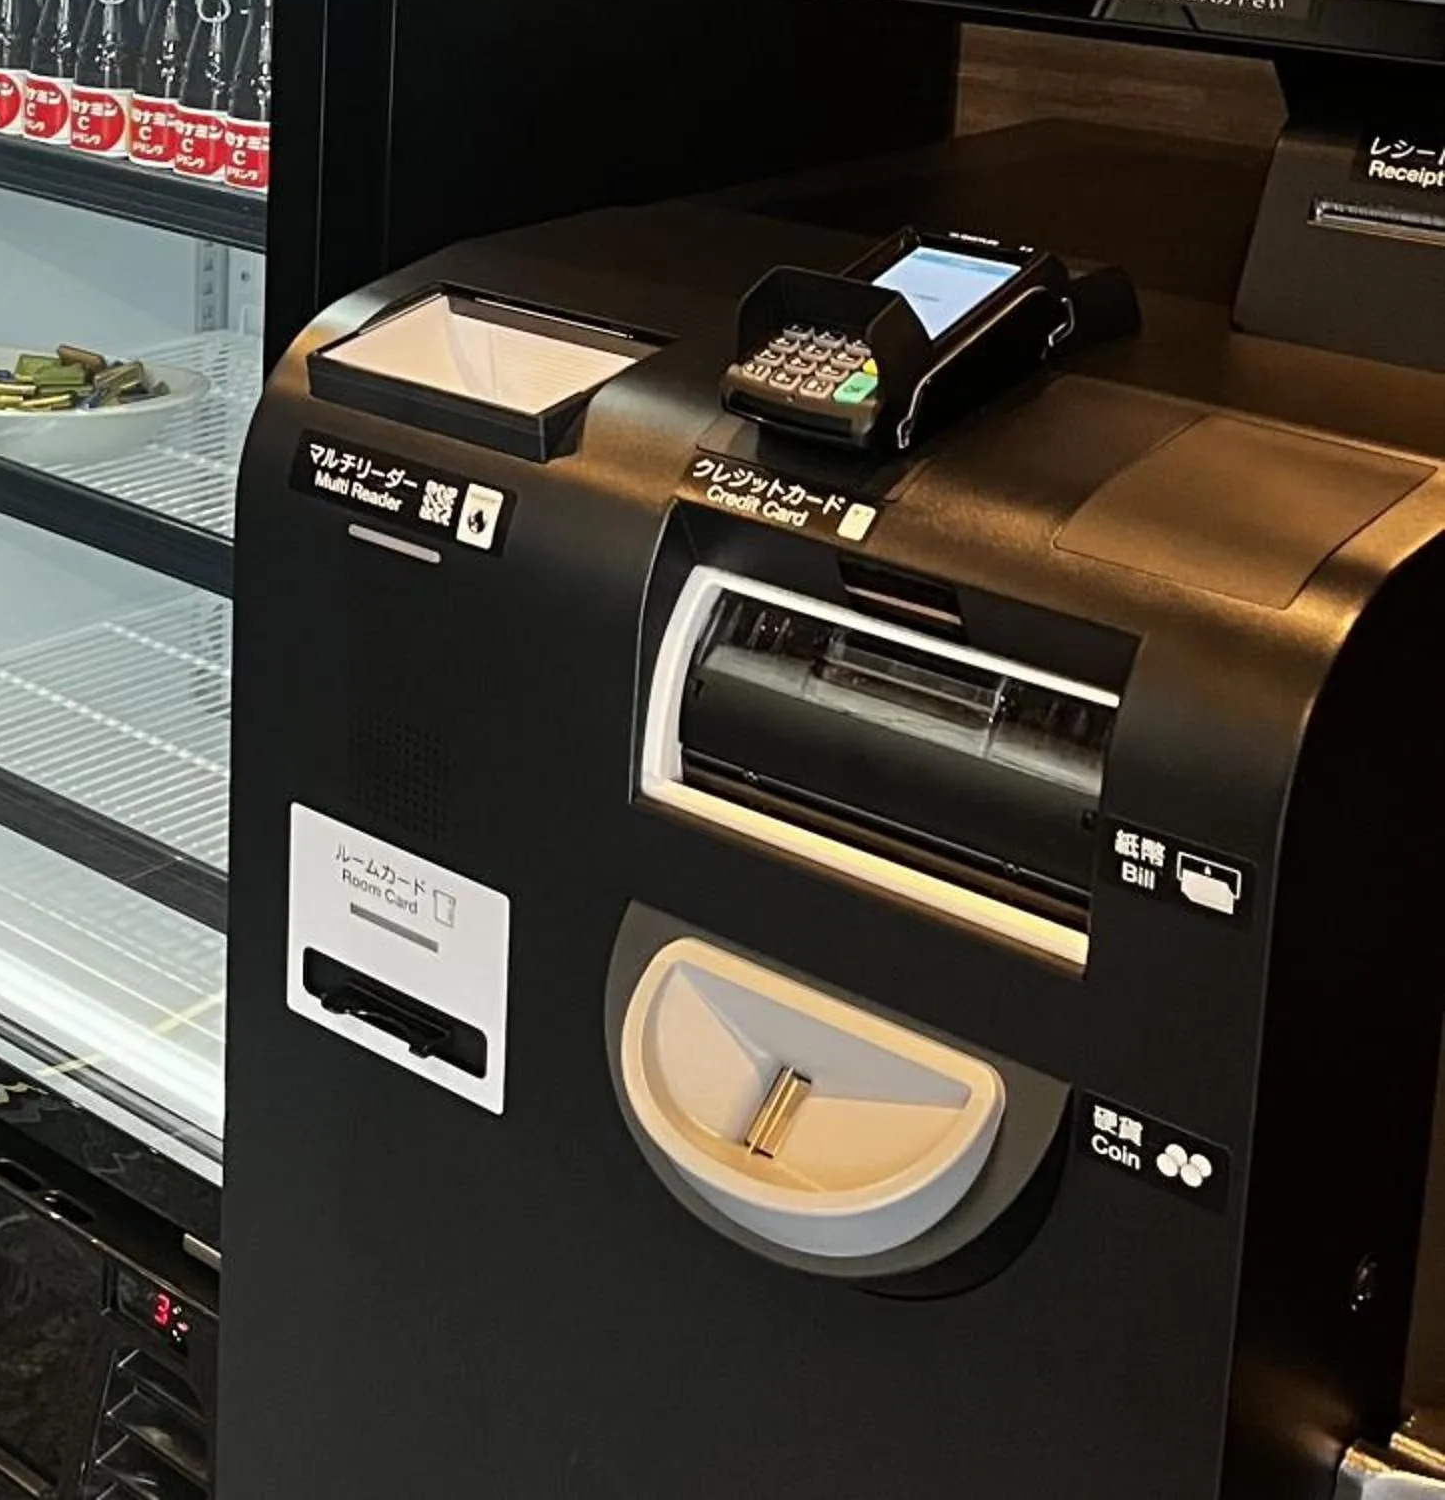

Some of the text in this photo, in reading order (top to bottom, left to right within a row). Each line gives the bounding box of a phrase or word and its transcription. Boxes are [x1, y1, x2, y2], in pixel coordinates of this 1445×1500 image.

[1368, 159, 1445, 188] Receipt
[310, 443, 418, 488] マルチリーダー
[693, 459, 846, 514] クレジットカード
[315, 470, 404, 512] Multi Reader
[707, 485, 809, 527] Credit Card
[336, 842, 426, 895] ルームカード
[1122, 861, 1155, 891] Bill
[342, 867, 418, 914] Room Card
[1091, 1134, 1141, 1170] Coin
